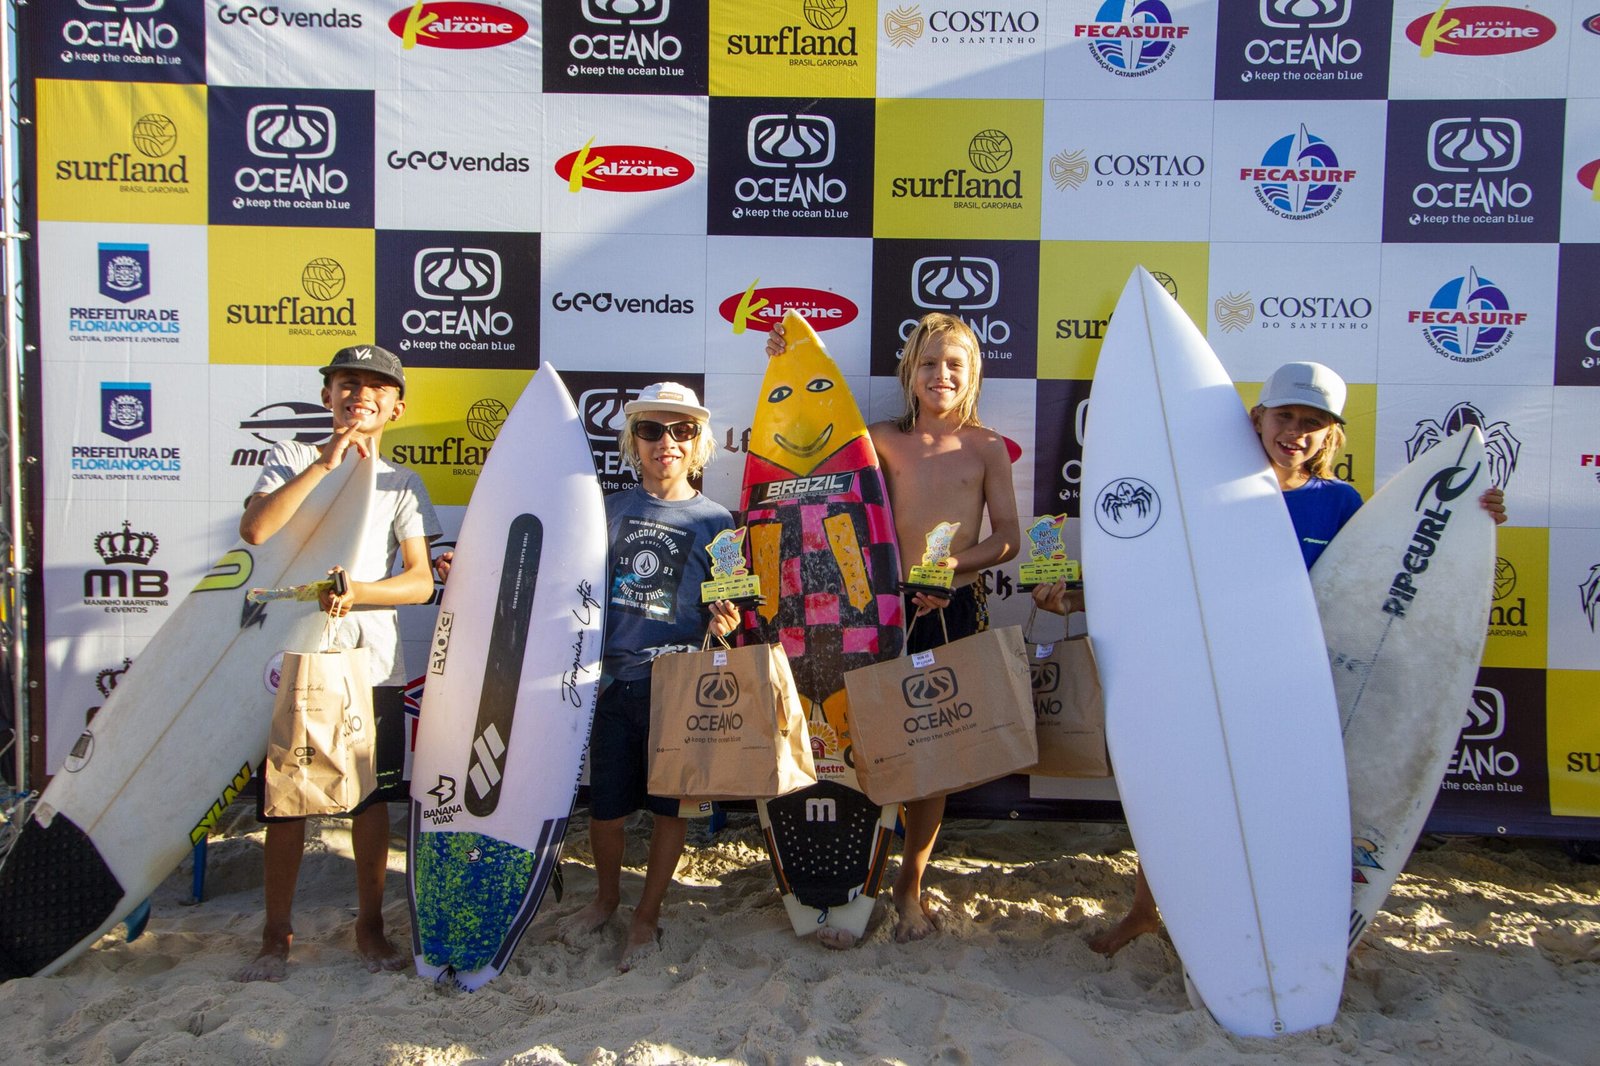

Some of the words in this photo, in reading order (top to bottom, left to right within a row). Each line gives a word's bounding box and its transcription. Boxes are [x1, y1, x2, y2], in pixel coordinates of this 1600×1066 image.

[62, 17, 179, 54] OCEANO
[959, 36, 1036, 44] SANTINHO
[1074, 24, 1190, 39] FECASURF
[569, 29, 682, 67] OCEANO
[727, 26, 858, 56] surfland
[75, 51, 100, 63] keep
[103, 52, 120, 62] the
[122, 54, 154, 64] ocean
[157, 55, 182, 65] blue
[1087, 42, 1114, 75] FEDERAÇÃO
[1114, 65, 1158, 78] CATARINENSE
[1158, 58, 1167, 69] DE
[1164, 44, 1178, 61] SURF
[1245, 33, 1362, 72] OCEANO
[580, 65, 605, 76] keep
[607, 66, 625, 75] the
[627, 67, 657, 76] ocean
[659, 66, 684, 76] blue
[817, 59, 858, 67] GAROPABA
[1255, 71, 1280, 82] keep
[1283, 71, 1301, 80] the
[1303, 72, 1334, 81] ocean
[1337, 71, 1363, 81] blue
[56, 153, 189, 184] surfland
[1240, 168, 1356, 183] FECASURF
[235, 163, 348, 199] OCEANO
[892, 169, 1023, 199] surfland
[1097, 180, 1114, 188] DO
[1125, 180, 1201, 188] SANTINHO
[147, 186, 189, 194] GAROPABA
[735, 173, 847, 209] OCEANO
[1412, 177, 1532, 214] OCEANO
[246, 199, 271, 209] keep
[274, 199, 290, 208] the
[293, 201, 323, 209] ocean
[325, 200, 350, 209] blue
[982, 202, 1023, 210] GAROPABA
[1253, 186, 1280, 218] FEDERAÇÃO
[1280, 209, 1323, 221] CATARINENSE
[1323, 201, 1333, 212] DE
[1330, 187, 1344, 205] SURF
[745, 208, 770, 218] keep
[772, 208, 790, 218] the
[792, 210, 822, 219] ocean
[824, 209, 849, 219] blue
[1423, 214, 1449, 224] keep
[1452, 214, 1470, 223] the
[1473, 216, 1504, 224] ocean
[1508, 214, 1534, 224] blue
[70, 308, 158, 321] PREFEITURA
[160, 308, 179, 321] DE
[227, 297, 356, 326] surfland
[1408, 311, 1528, 325] FECASURF
[402, 305, 513, 341] OCEANO
[899, 314, 1010, 344] ONO
[1291, 322, 1368, 330] SANTINHO
[413, 340, 437, 350] keep
[440, 341, 456, 350] the
[459, 342, 489, 350] ocean
[492, 341, 515, 351] blue
[1422, 328, 1450, 358] FEDERAÇÃO
[1450, 352, 1494, 362] CATARINENSE
[1495, 345, 1504, 354] DE
[1502, 330, 1514, 348] SURF
[988, 351, 1012, 360] blue
[72, 446, 158, 459] PREFEITURA
[160, 447, 180, 460] DE
[392, 438, 490, 465] surfla
[592, 451, 638, 481] CEA
[602, 481, 619, 490] the
[624, 528, 656, 544] VOLCOM
[658, 532, 679, 555] STONE
[620, 557, 628, 565] 19
[663, 566, 674, 576] 91
[1382, 572, 1418, 620] RIP
[1402, 508, 1452, 574] CURL
[620, 581, 634, 598] TRUE
[635, 592, 644, 600] TO
[646, 588, 664, 600] THIS
[432, 612, 454, 675] EVOKE
[687, 711, 743, 734] OCEANO
[904, 702, 972, 734] OCEANO
[692, 736, 706, 744] keep
[932, 732, 944, 741] the
[944, 728, 961, 737] ocean
[1446, 744, 1520, 782] EANO
[1442, 781, 1460, 790] the
[1463, 782, 1494, 792] ocean
[1497, 782, 1522, 792] blue
[424, 804, 462, 819] BANANA
[432, 814, 454, 825] WAX
